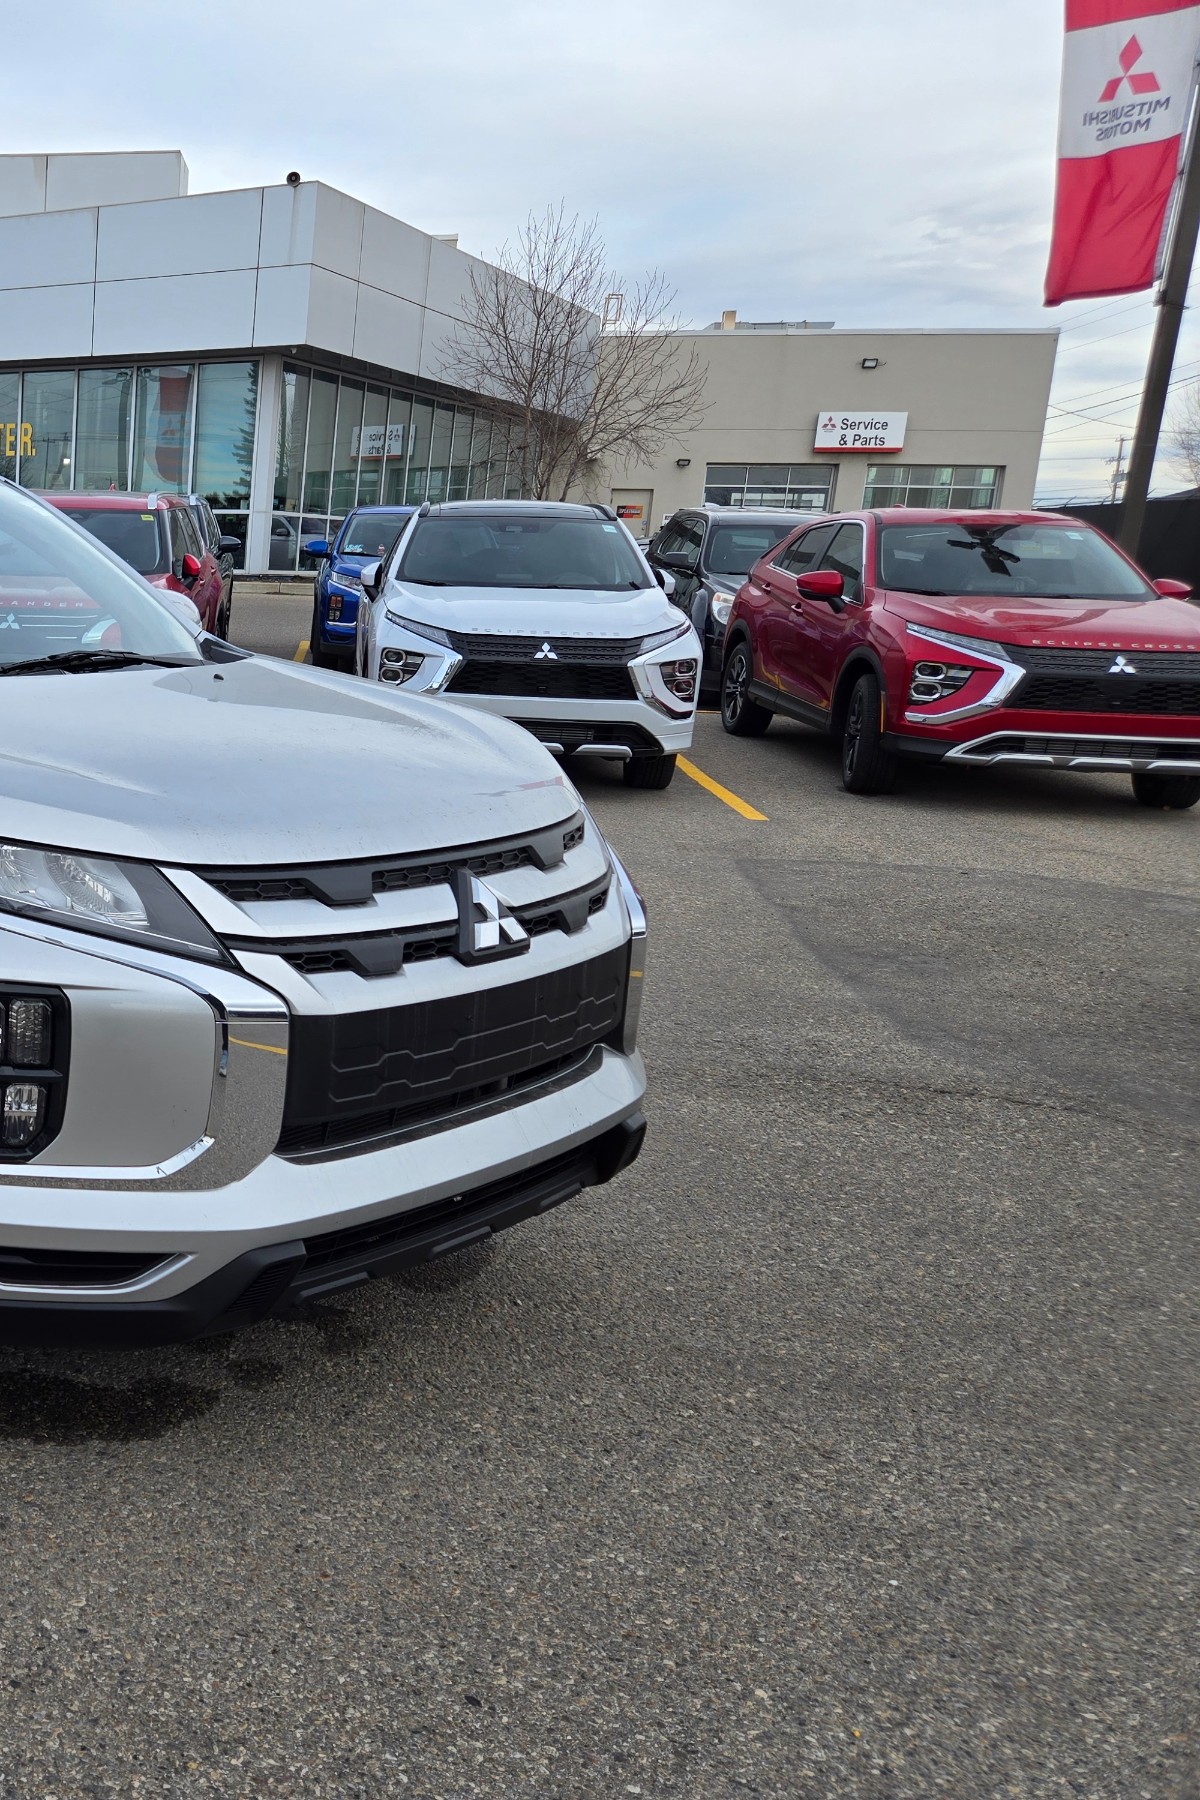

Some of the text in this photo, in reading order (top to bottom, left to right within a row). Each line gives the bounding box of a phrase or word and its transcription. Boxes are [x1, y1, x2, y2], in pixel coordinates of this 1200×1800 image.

[840, 418, 888, 431] Service
[838, 434, 885, 446] & Parts
[1031, 639, 1121, 648] ECLIPSE
